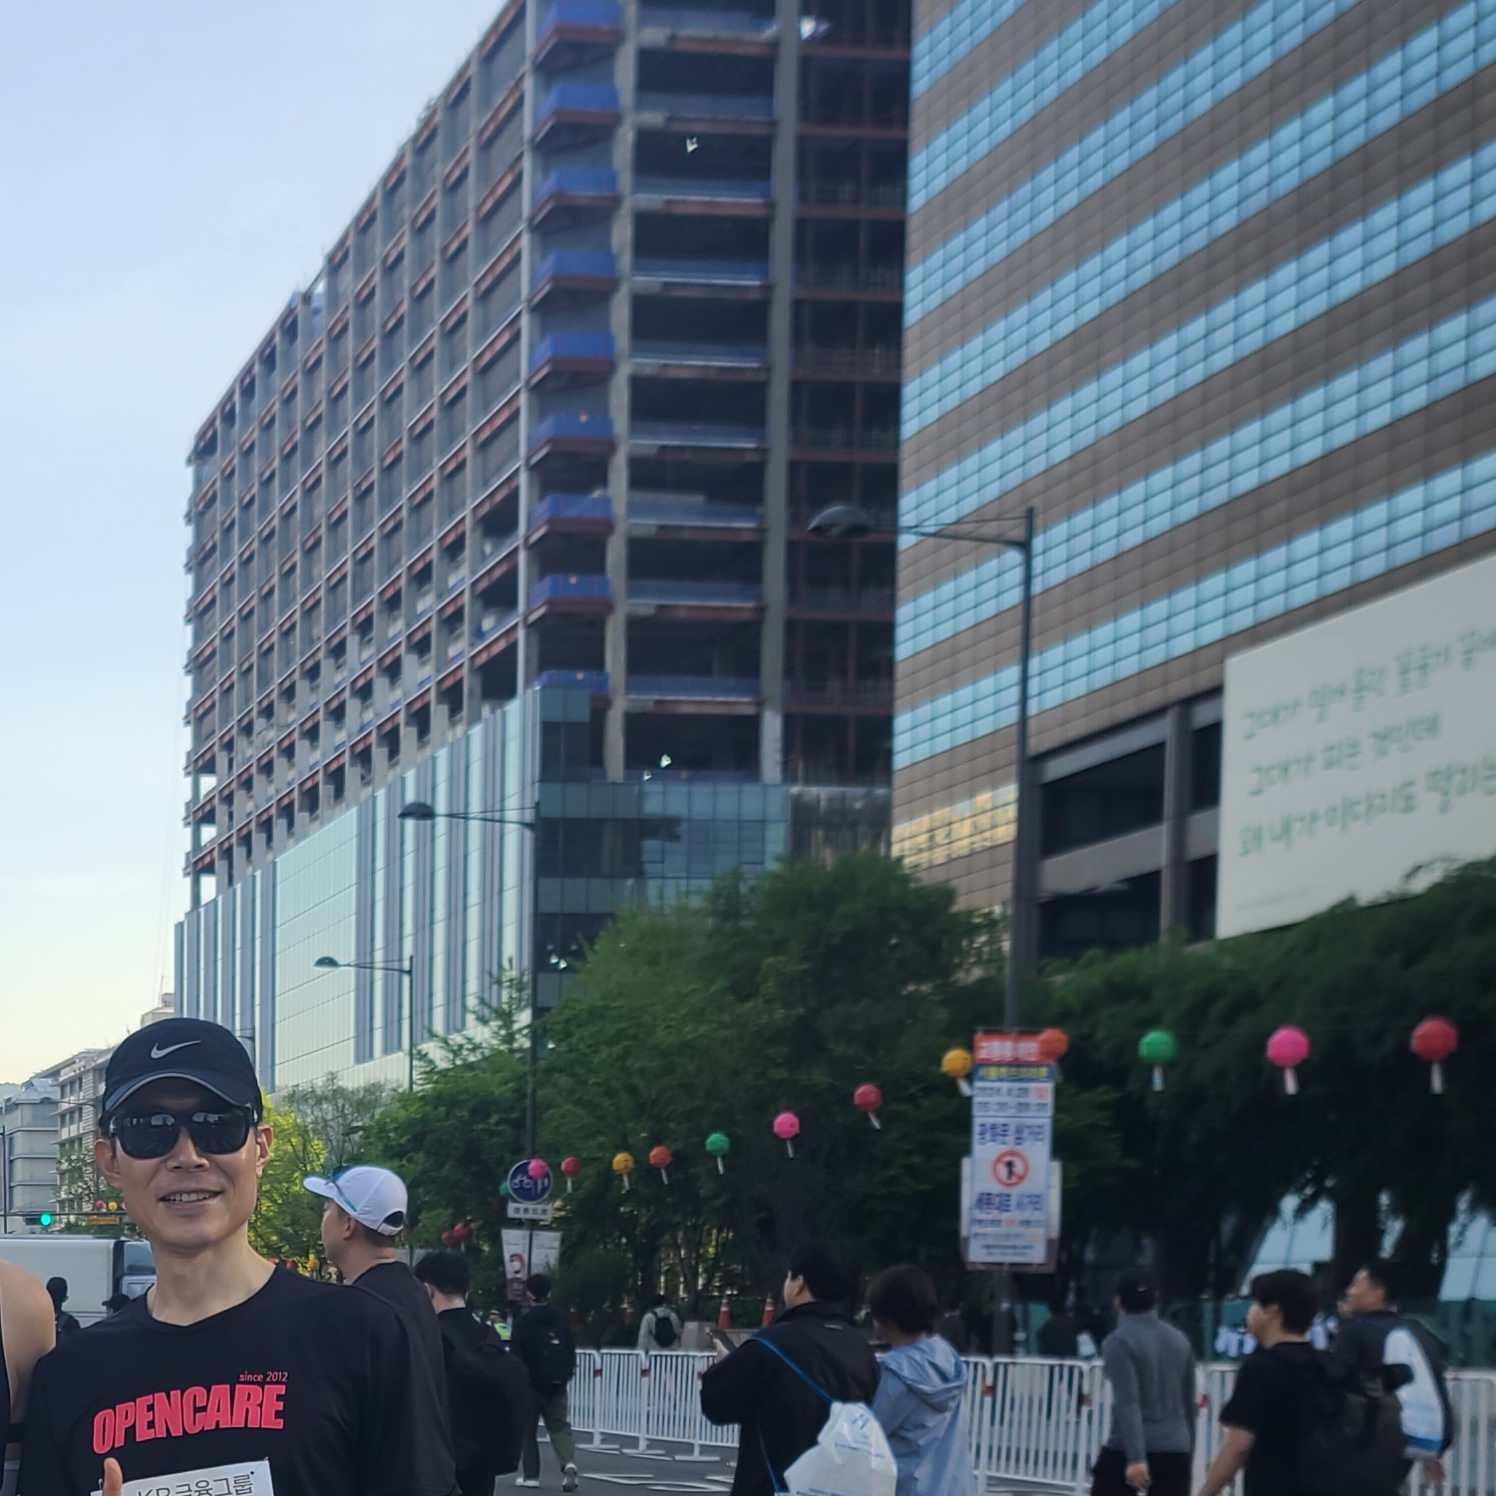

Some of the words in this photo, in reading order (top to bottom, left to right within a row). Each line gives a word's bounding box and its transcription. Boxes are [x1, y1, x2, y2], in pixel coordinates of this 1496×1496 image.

[239, 1371, 263, 1382] since
[266, 1371, 288, 1382] 2012
[93, 1384, 286, 1454] OPENCARE
